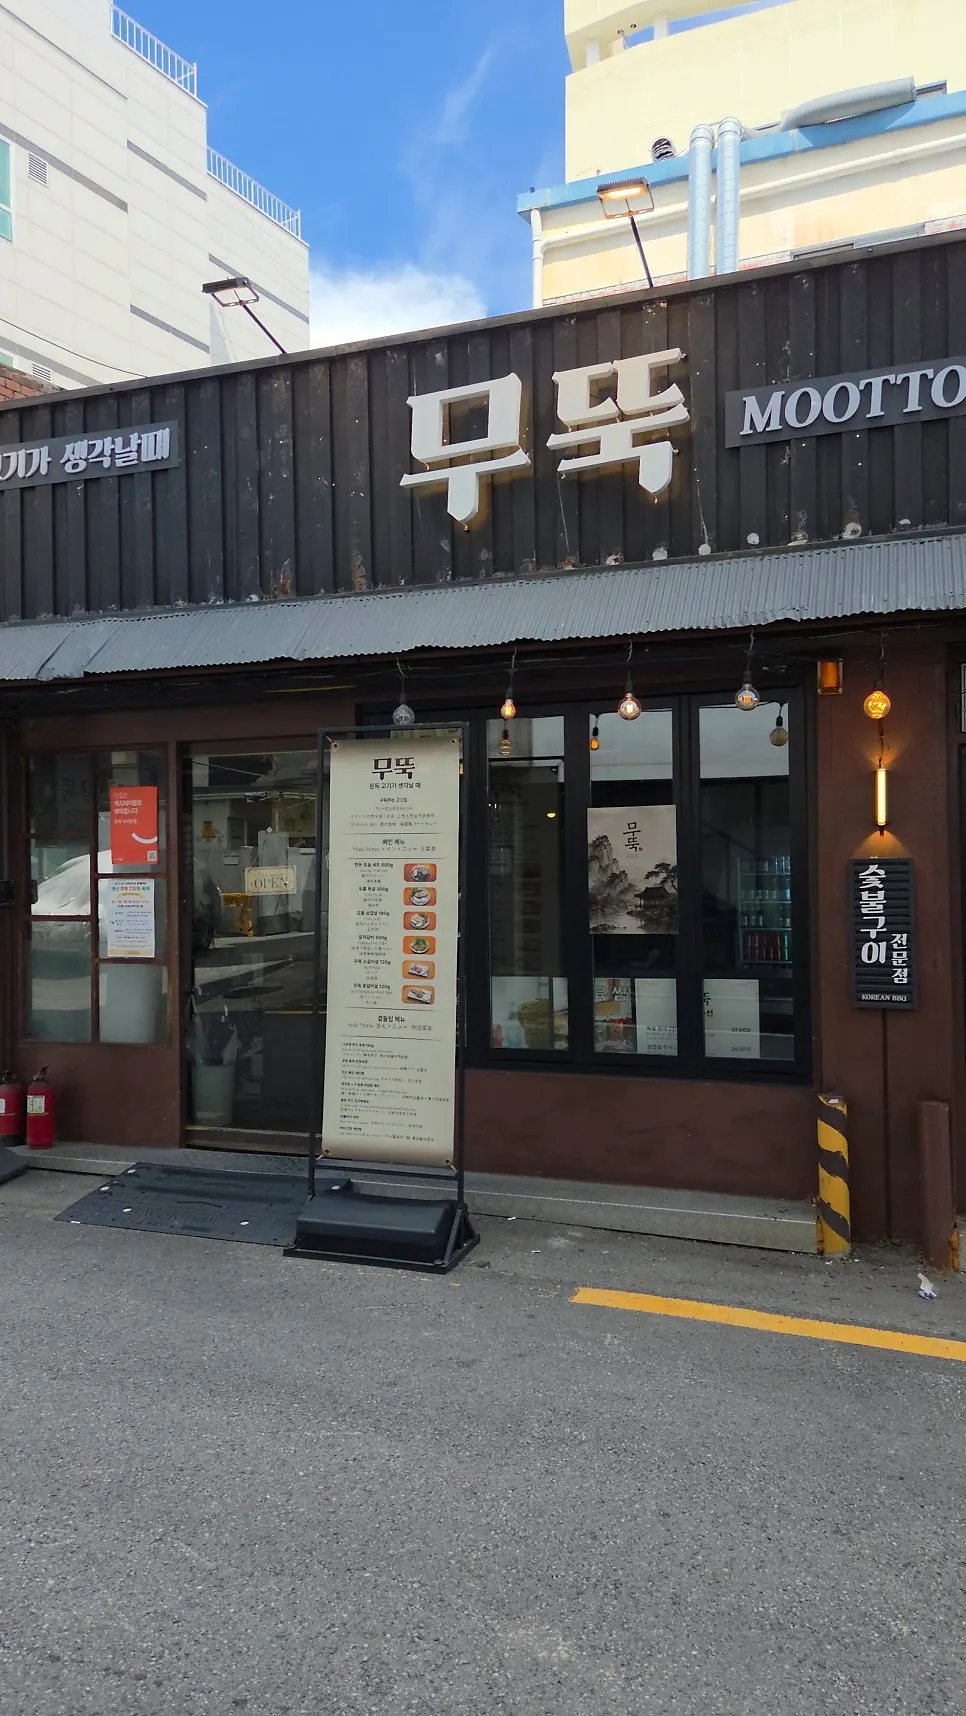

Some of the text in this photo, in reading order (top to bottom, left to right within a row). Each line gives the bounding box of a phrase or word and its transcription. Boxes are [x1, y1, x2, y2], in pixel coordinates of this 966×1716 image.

[739, 365, 966, 435] MOOTTO
[0, 427, 171, 481] 기가 생각날때
[400, 347, 690, 522] 무뚝
[371, 757, 416, 780] 무뚝
[622, 821, 642, 853] 무뚝
[254, 877, 288, 888] OPEN
[858, 864, 888, 964] 숯불구이
[890, 933, 909, 984] 전문점
[861, 993, 907, 1002] KOREAN BBQ
